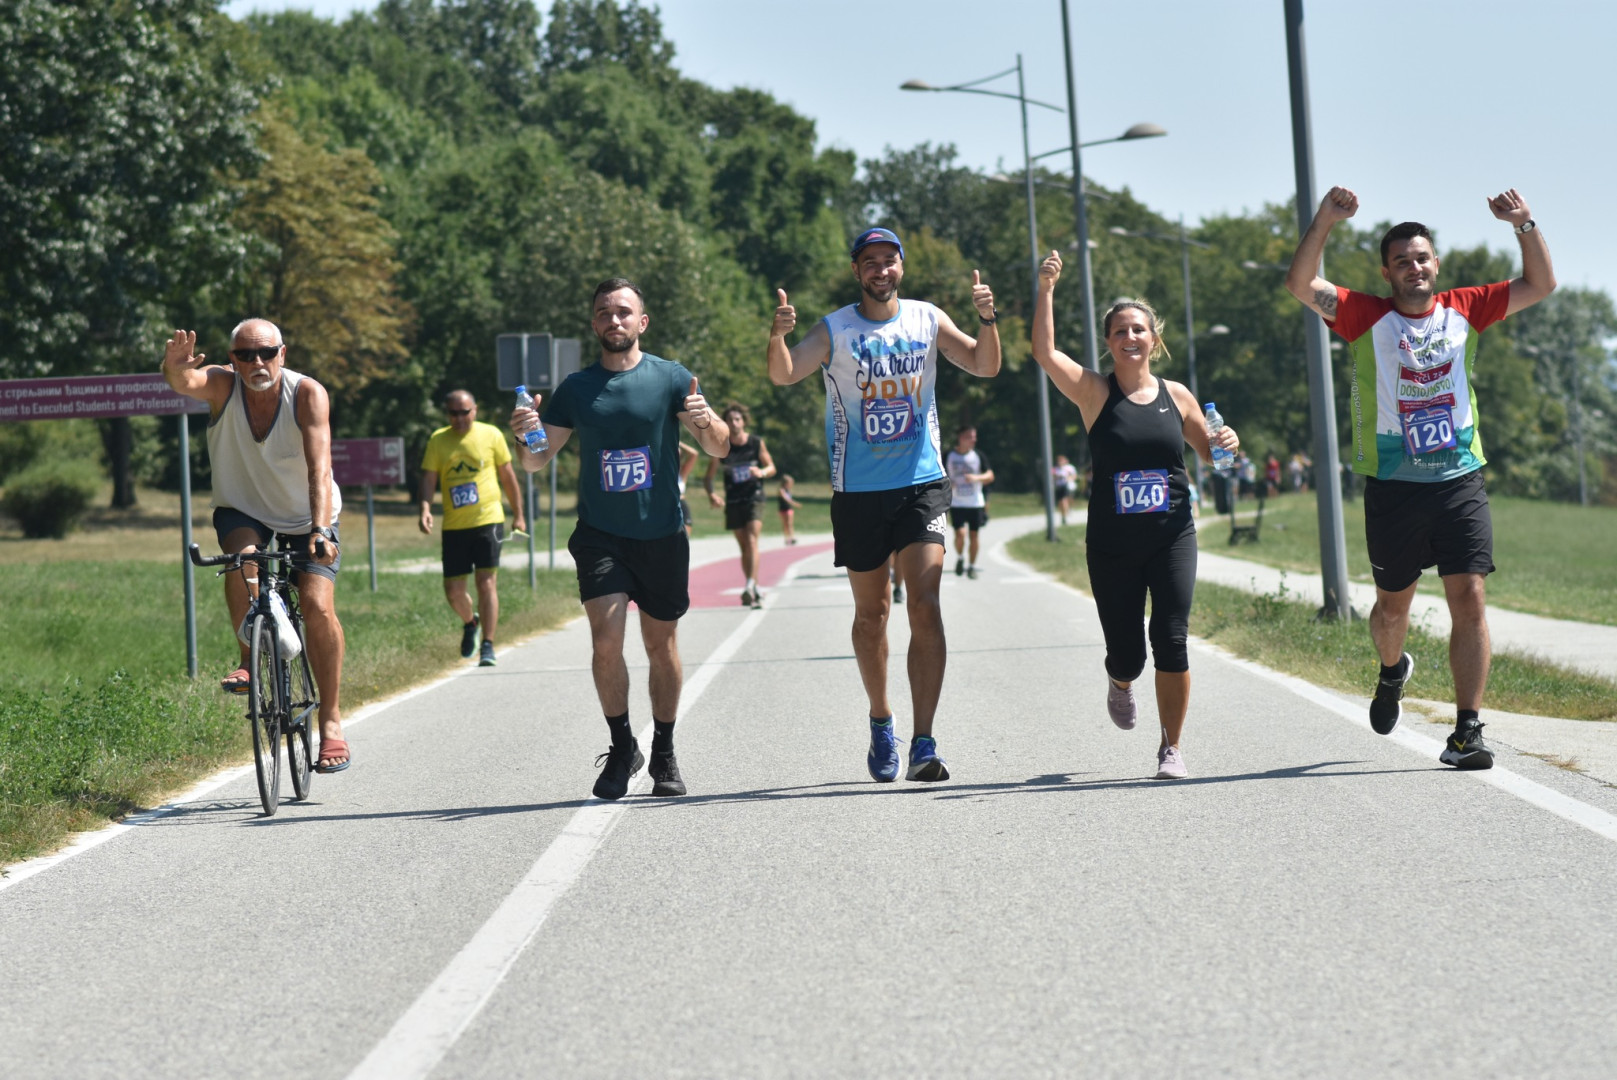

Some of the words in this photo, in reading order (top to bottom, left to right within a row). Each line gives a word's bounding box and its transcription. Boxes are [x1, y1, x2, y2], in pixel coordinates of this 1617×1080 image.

[856, 348, 886, 391] Ja
[888, 349, 925, 377] trčim
[21, 404, 31, 414] to
[32, 401, 74, 414] Executed
[76, 399, 116, 412] Students
[118, 399, 135, 409] and
[136, 398, 185, 409] Professors
[865, 411, 909, 436] 037
[1409, 420, 1452, 448] 120
[605, 462, 646, 487] 175
[453, 489, 478, 506] 026
[1120, 484, 1164, 508] 040
